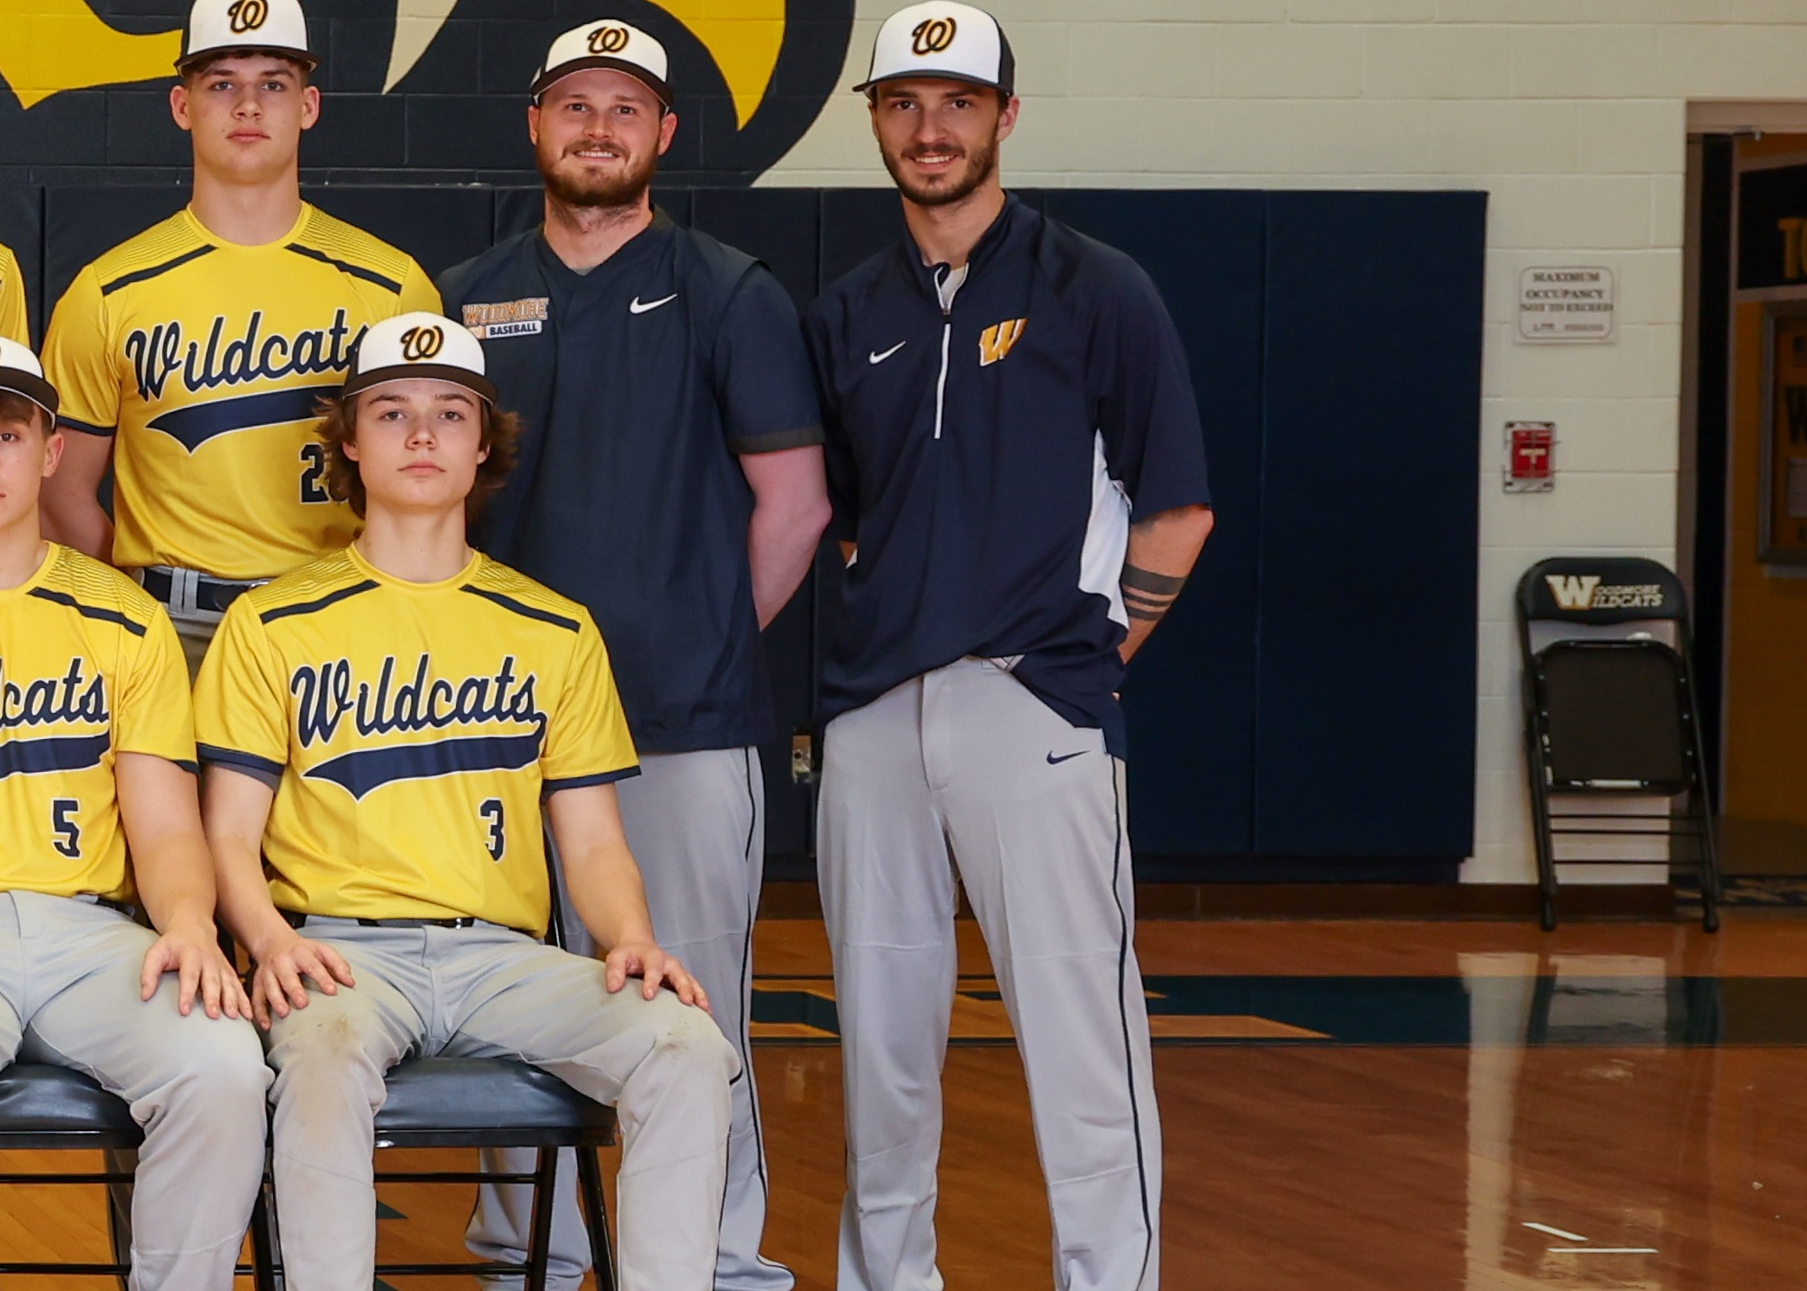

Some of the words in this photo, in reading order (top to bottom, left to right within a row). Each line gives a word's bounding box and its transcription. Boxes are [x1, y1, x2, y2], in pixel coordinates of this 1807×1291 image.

[462, 297, 549, 326] WOODMORE
[490, 322, 537, 336] BASEBALL
[979, 318, 1028, 367] W
[290, 653, 545, 748] Wildcats
[53, 798, 81, 859] 5
[479, 798, 504, 863] 3
